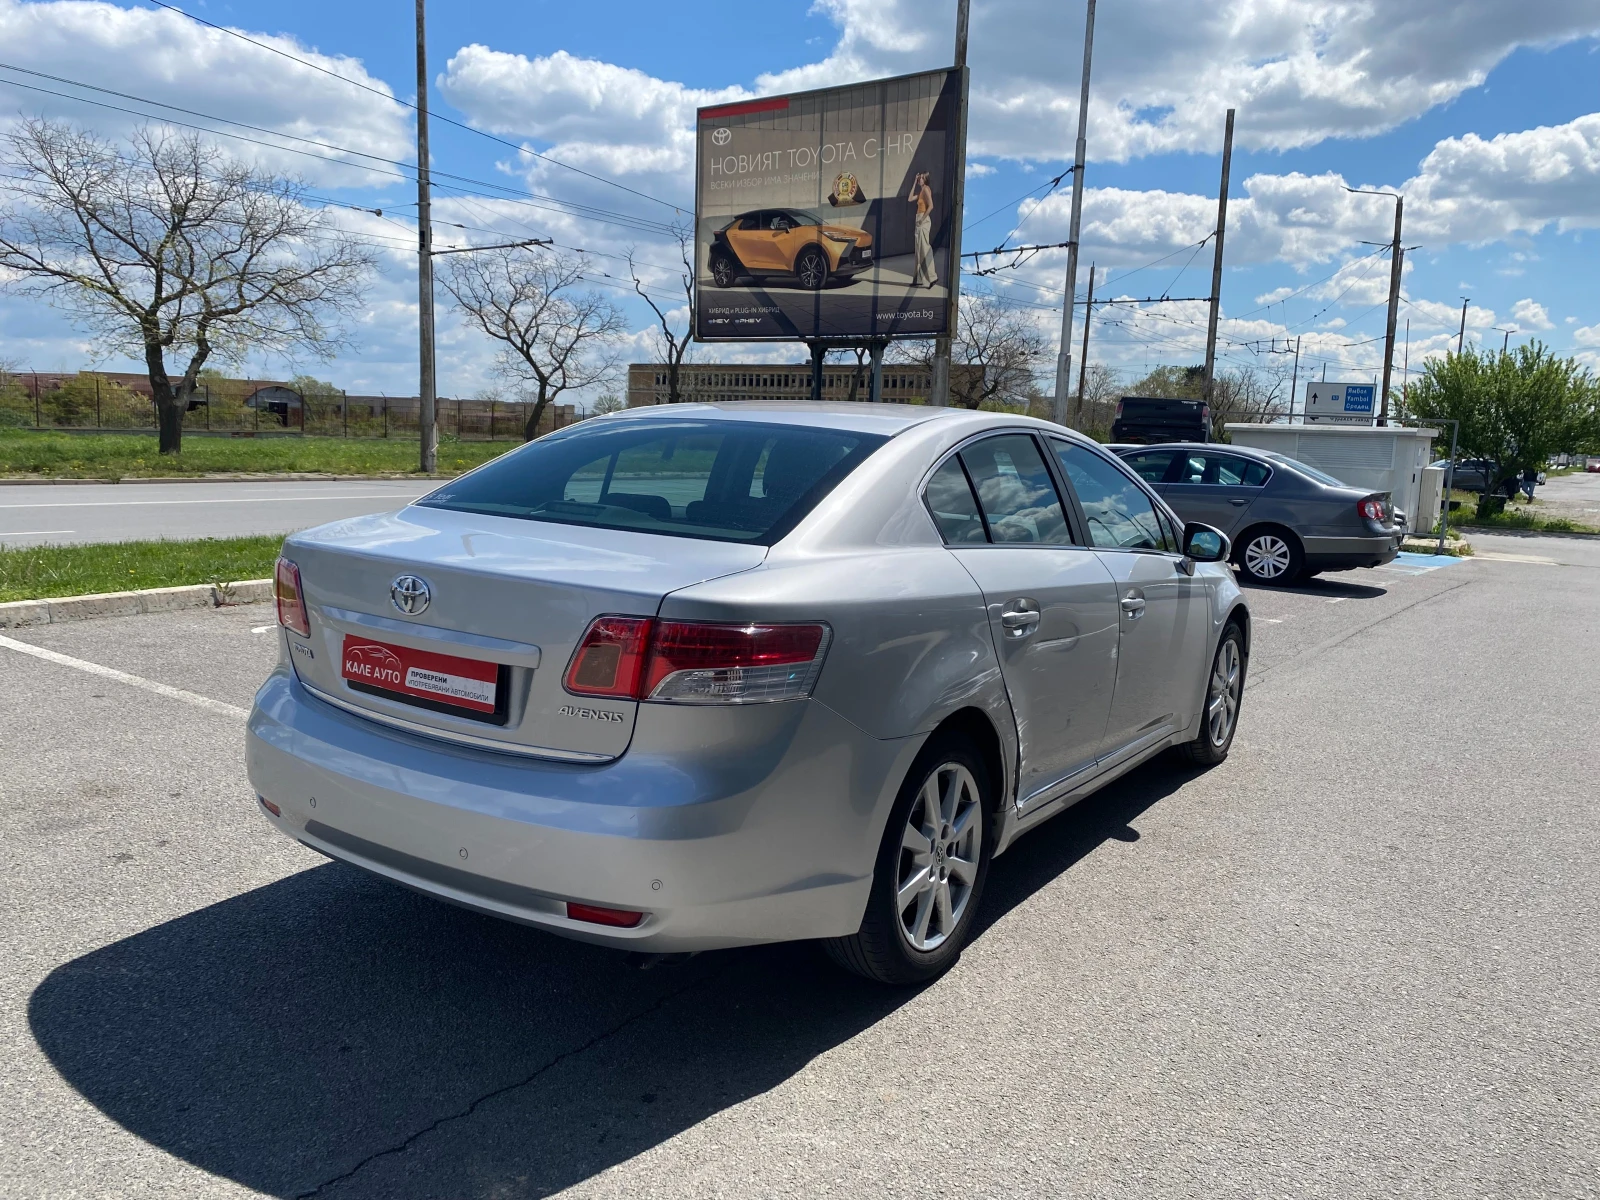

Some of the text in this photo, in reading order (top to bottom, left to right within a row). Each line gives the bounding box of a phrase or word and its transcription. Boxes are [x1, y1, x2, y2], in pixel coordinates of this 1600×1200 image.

[711, 133, 914, 176] НОВИЯТ TOYOTA C-HR
[710, 180, 735, 190] ВСЕКИ
[737, 178, 762, 188] ИЗБОР
[765, 176, 782, 185] ИМА
[758, 306, 780, 314] ХИБРИД
[876, 309, 934, 320] www.toyota.bg
[346, 660, 400, 684] КАЛЕ АУТО
[410, 670, 448, 684] ПРОВЕРЕНИ
[408, 679, 489, 702] УПОТРЕБЯВАНИ АВТОМОБИЛИ
[557, 705, 624, 723] AVENSIS
